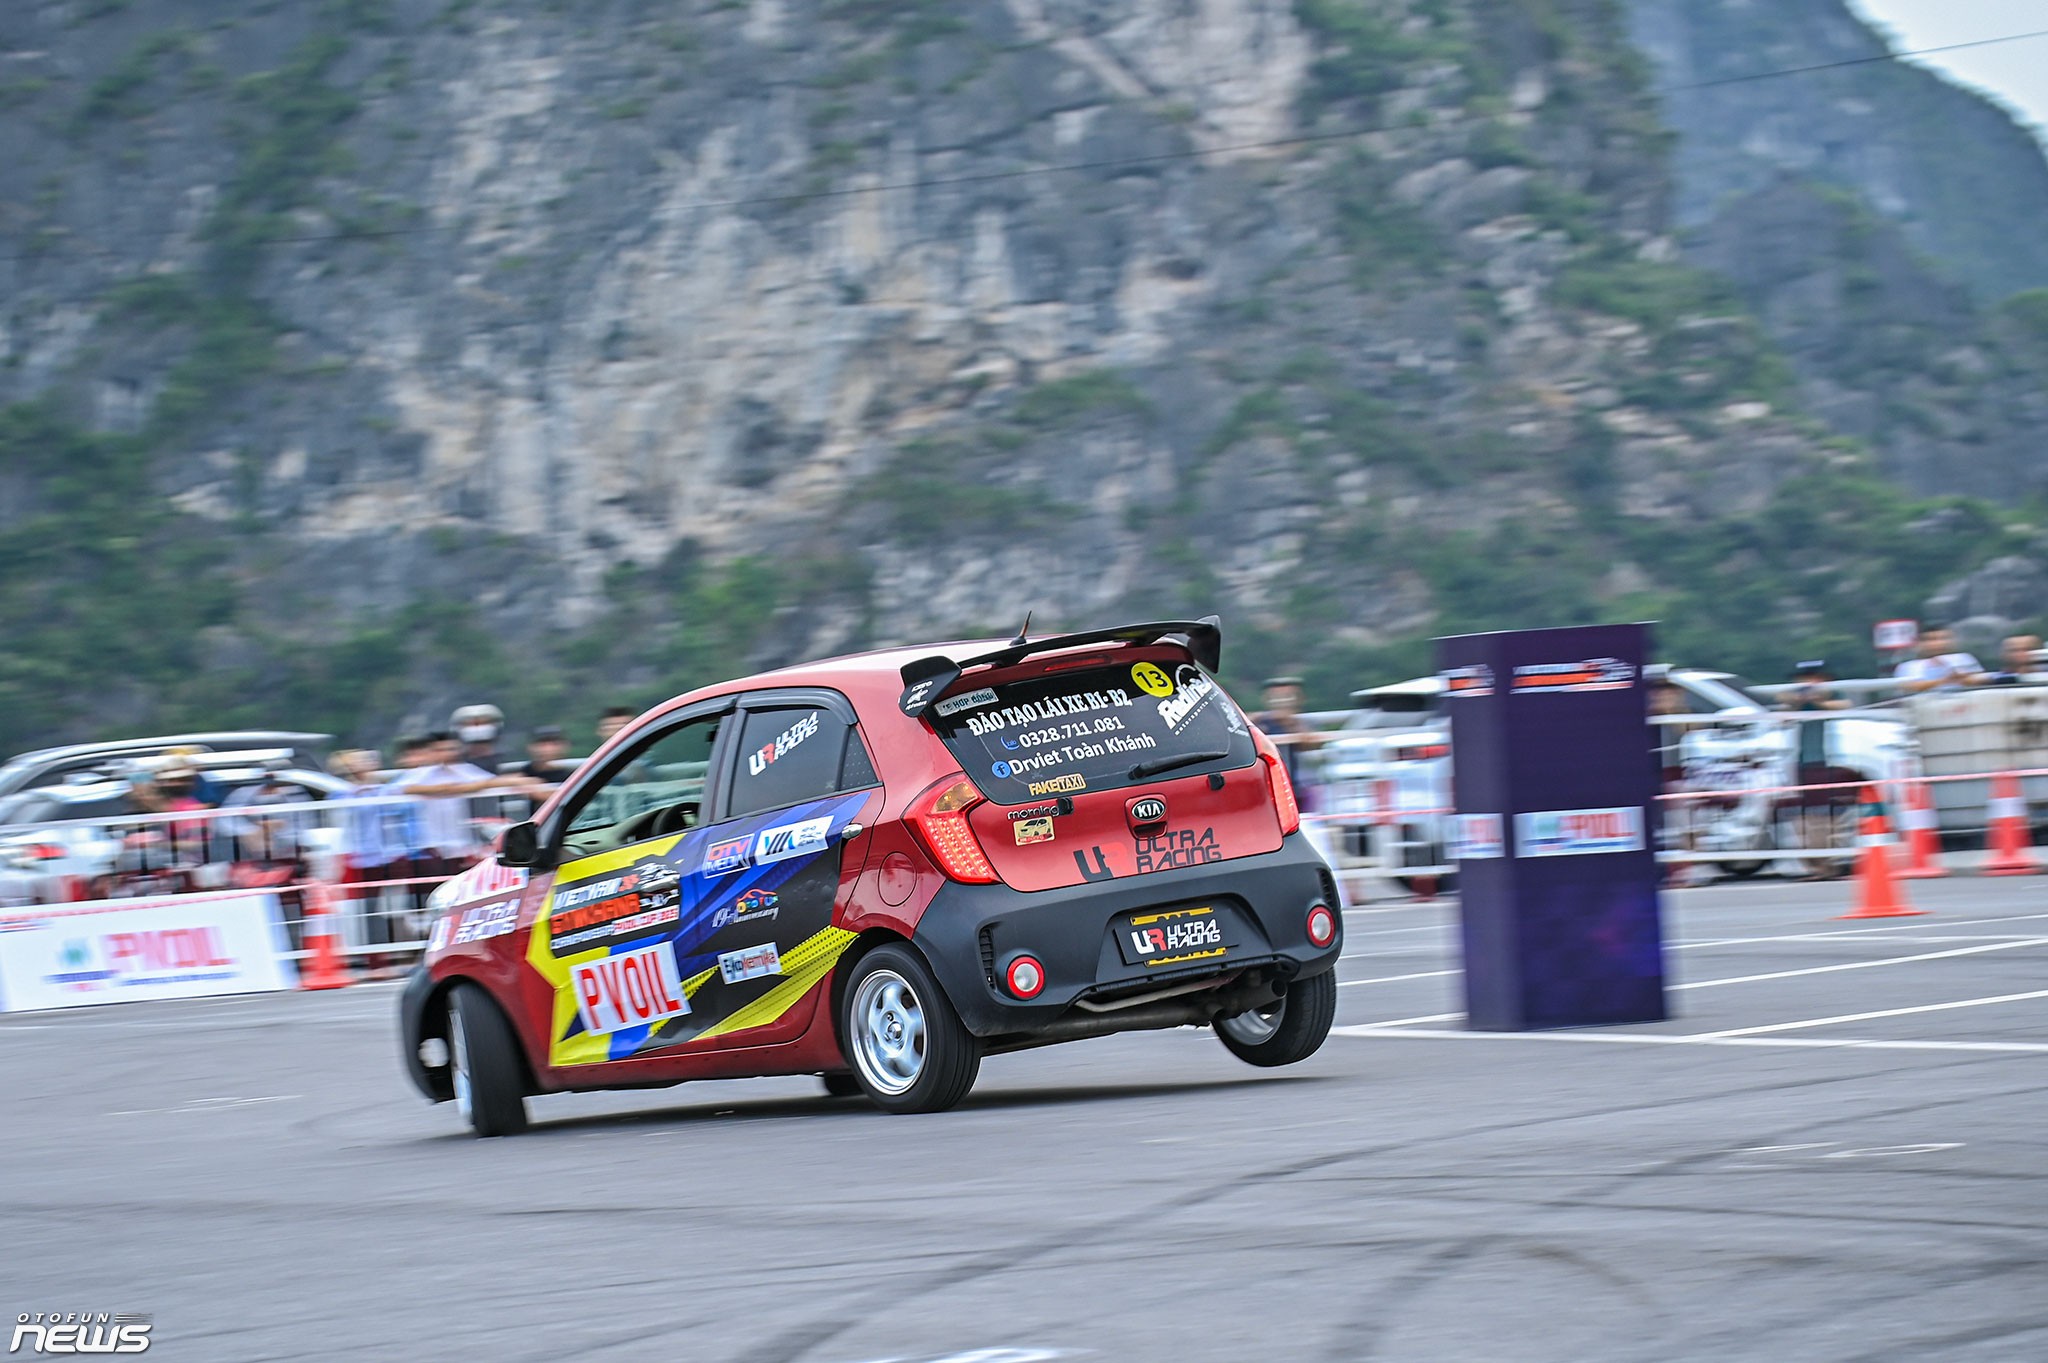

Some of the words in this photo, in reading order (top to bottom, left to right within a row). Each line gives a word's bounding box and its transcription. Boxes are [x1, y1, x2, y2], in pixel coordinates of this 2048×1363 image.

[1136, 671, 1168, 688] 13
[966, 712, 1005, 736] ĐÀO
[1001, 706, 1038, 728] TẠO
[1034, 696, 1067, 719] LÁI
[1062, 692, 1089, 714] XE
[774, 725, 818, 760] RACING
[775, 711, 819, 747] ULTRA
[1018, 716, 1125, 748] 0328.711.081
[1008, 750, 1063, 775] Drviet
[1060, 742, 1105, 762] Toàn
[1104, 732, 1157, 754] Khánh
[1007, 805, 1060, 820] morning
[1137, 803, 1161, 818] KIA
[1135, 827, 1215, 855] ULTRA
[1136, 844, 1222, 874] RACING
[1131, 928, 1167, 954] UR
[1166, 919, 1217, 937] ULTRA
[1167, 929, 1221, 950] RACING
[578, 951, 682, 1029] PVOIL
